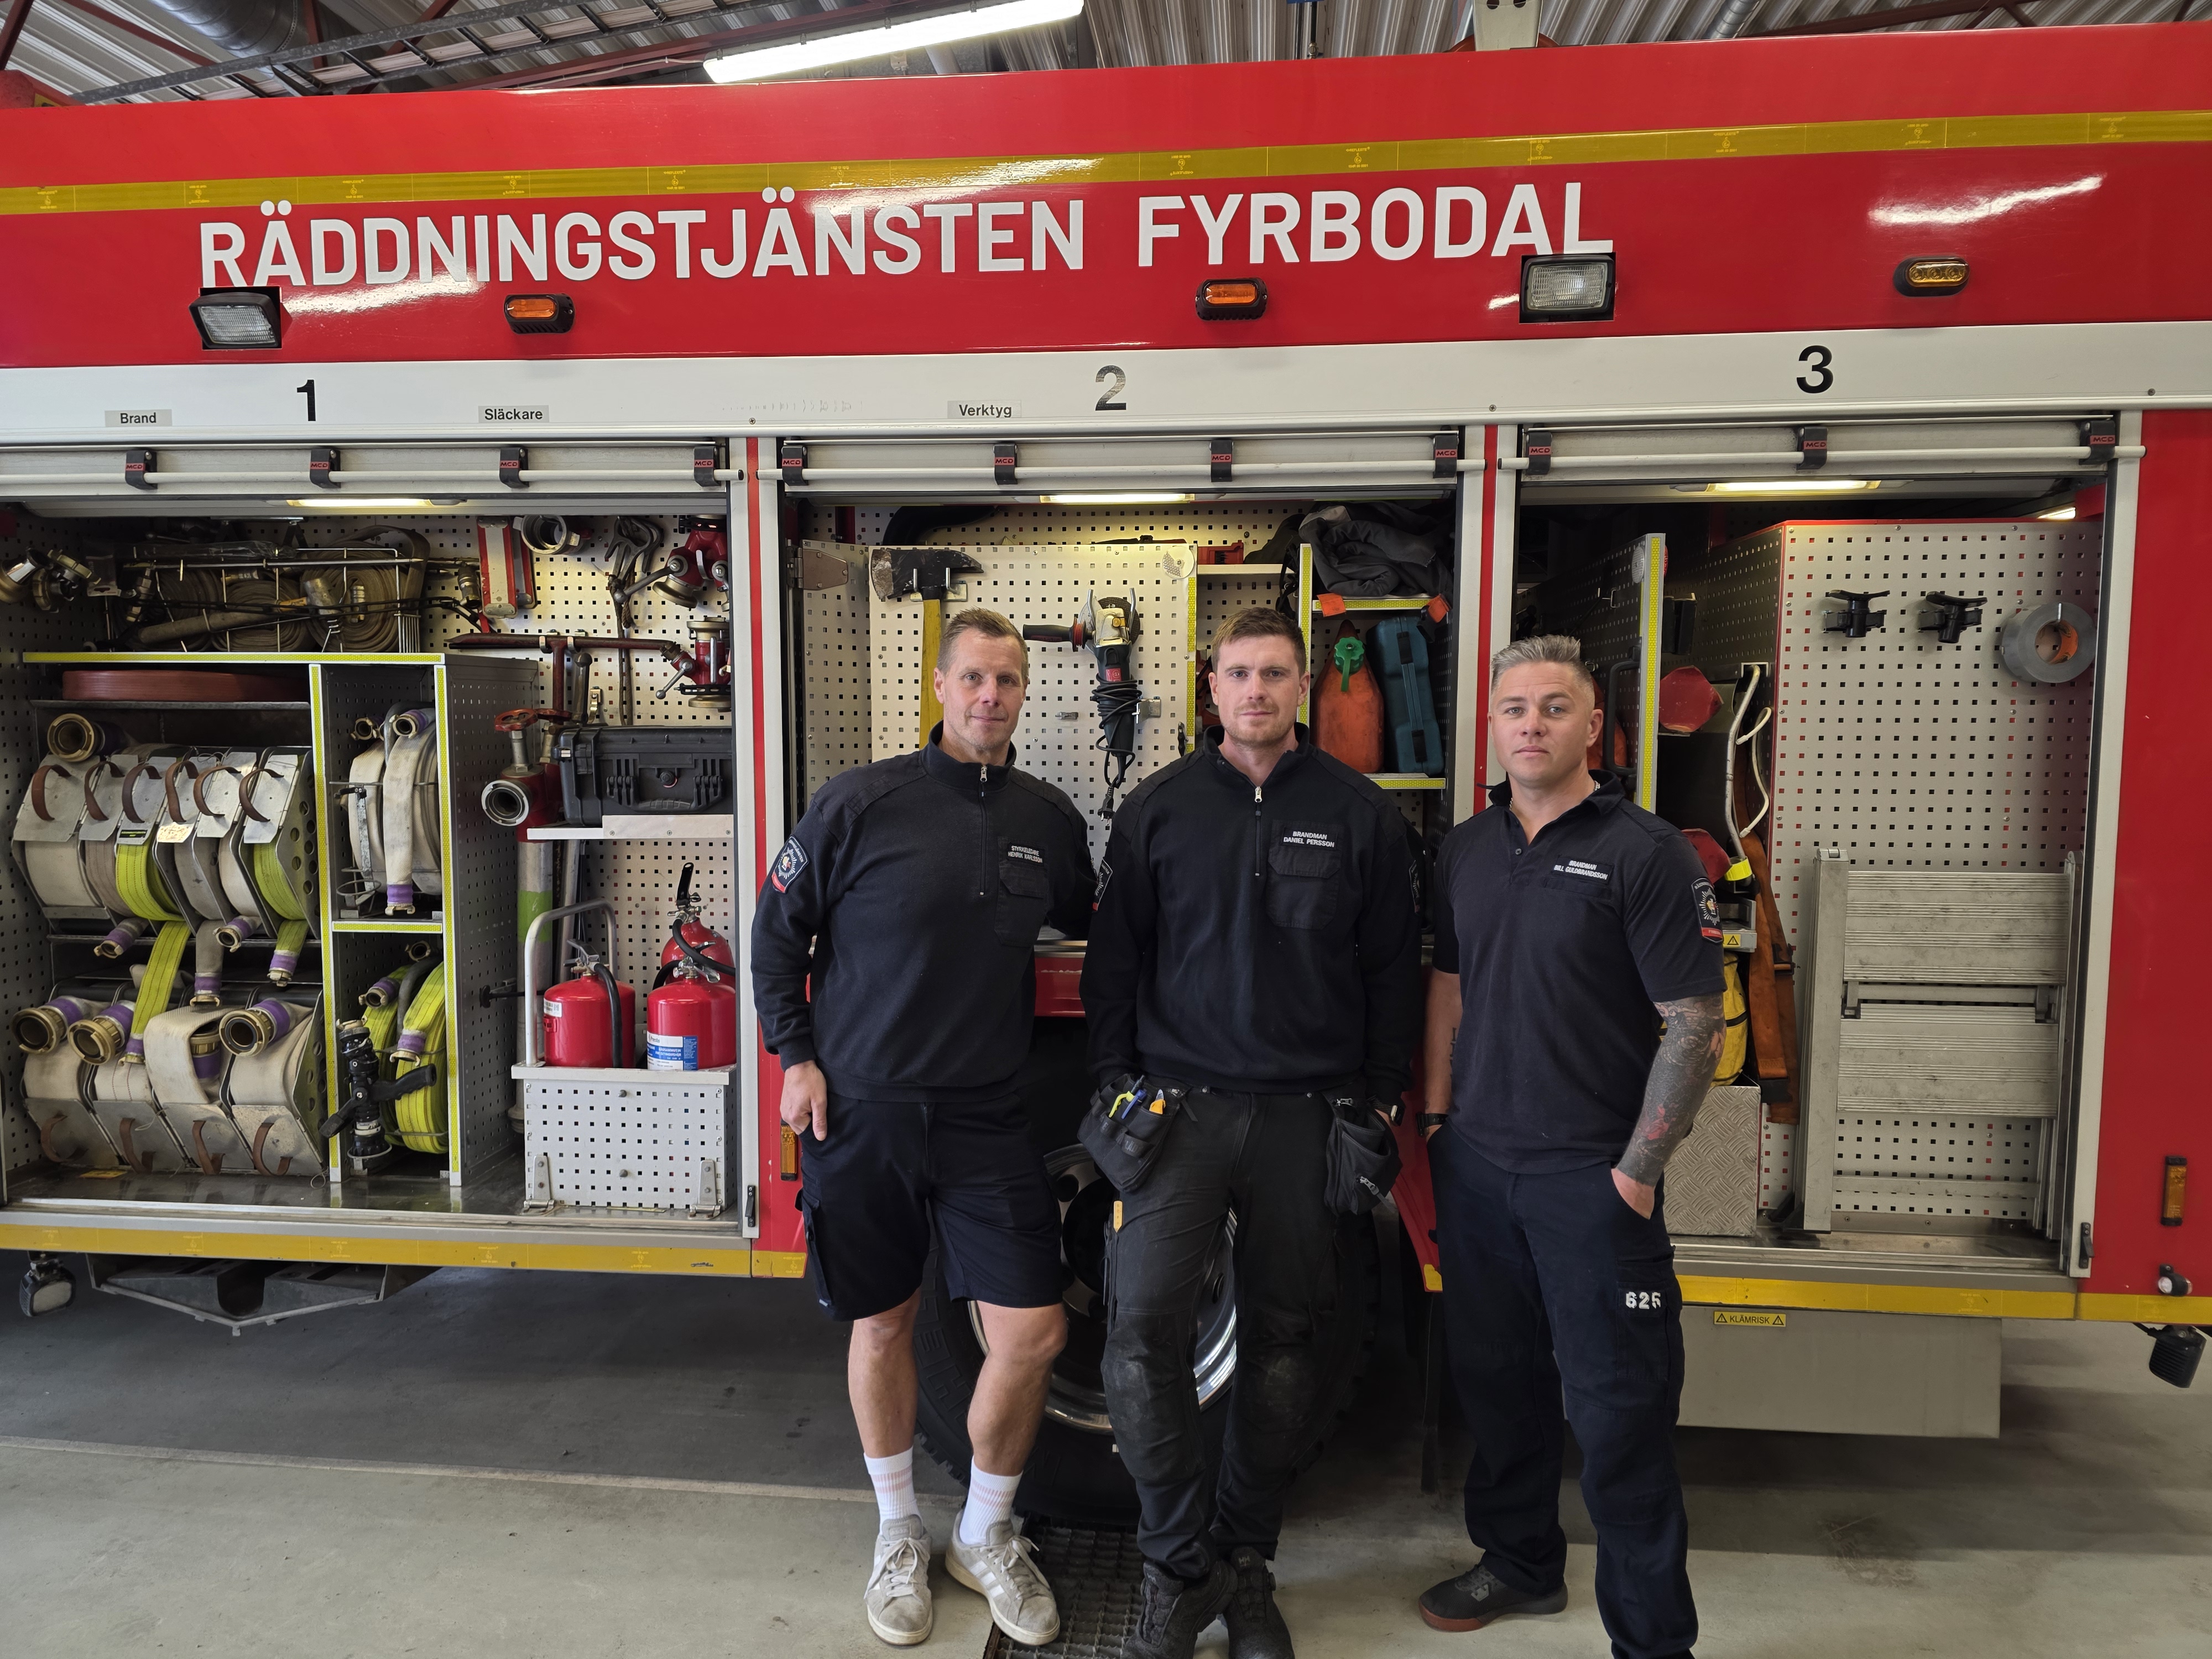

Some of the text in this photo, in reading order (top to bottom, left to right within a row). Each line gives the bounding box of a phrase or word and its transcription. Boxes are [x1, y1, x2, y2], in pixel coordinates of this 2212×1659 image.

[200, 182, 1613, 287] RÄDDNINGSTJÄNSTEN FYRBODAL
[1796, 345, 1834, 394] 3
[1094, 365, 1126, 411] 2
[296, 379, 316, 421] 1
[119, 411, 157, 424] Brand
[484, 407, 543, 420] Släckare
[958, 404, 1012, 418] Verktyg
[1292, 831, 1327, 840] BRANDMAN
[1306, 838, 1335, 848] PERSSON
[1024, 853, 1043, 863] KARLSSON
[1568, 860, 1598, 870] BRANDMAN
[1565, 866, 1609, 880] GULDBRANDSSON
[1729, 1314, 1770, 1324] KLÄMRISK
